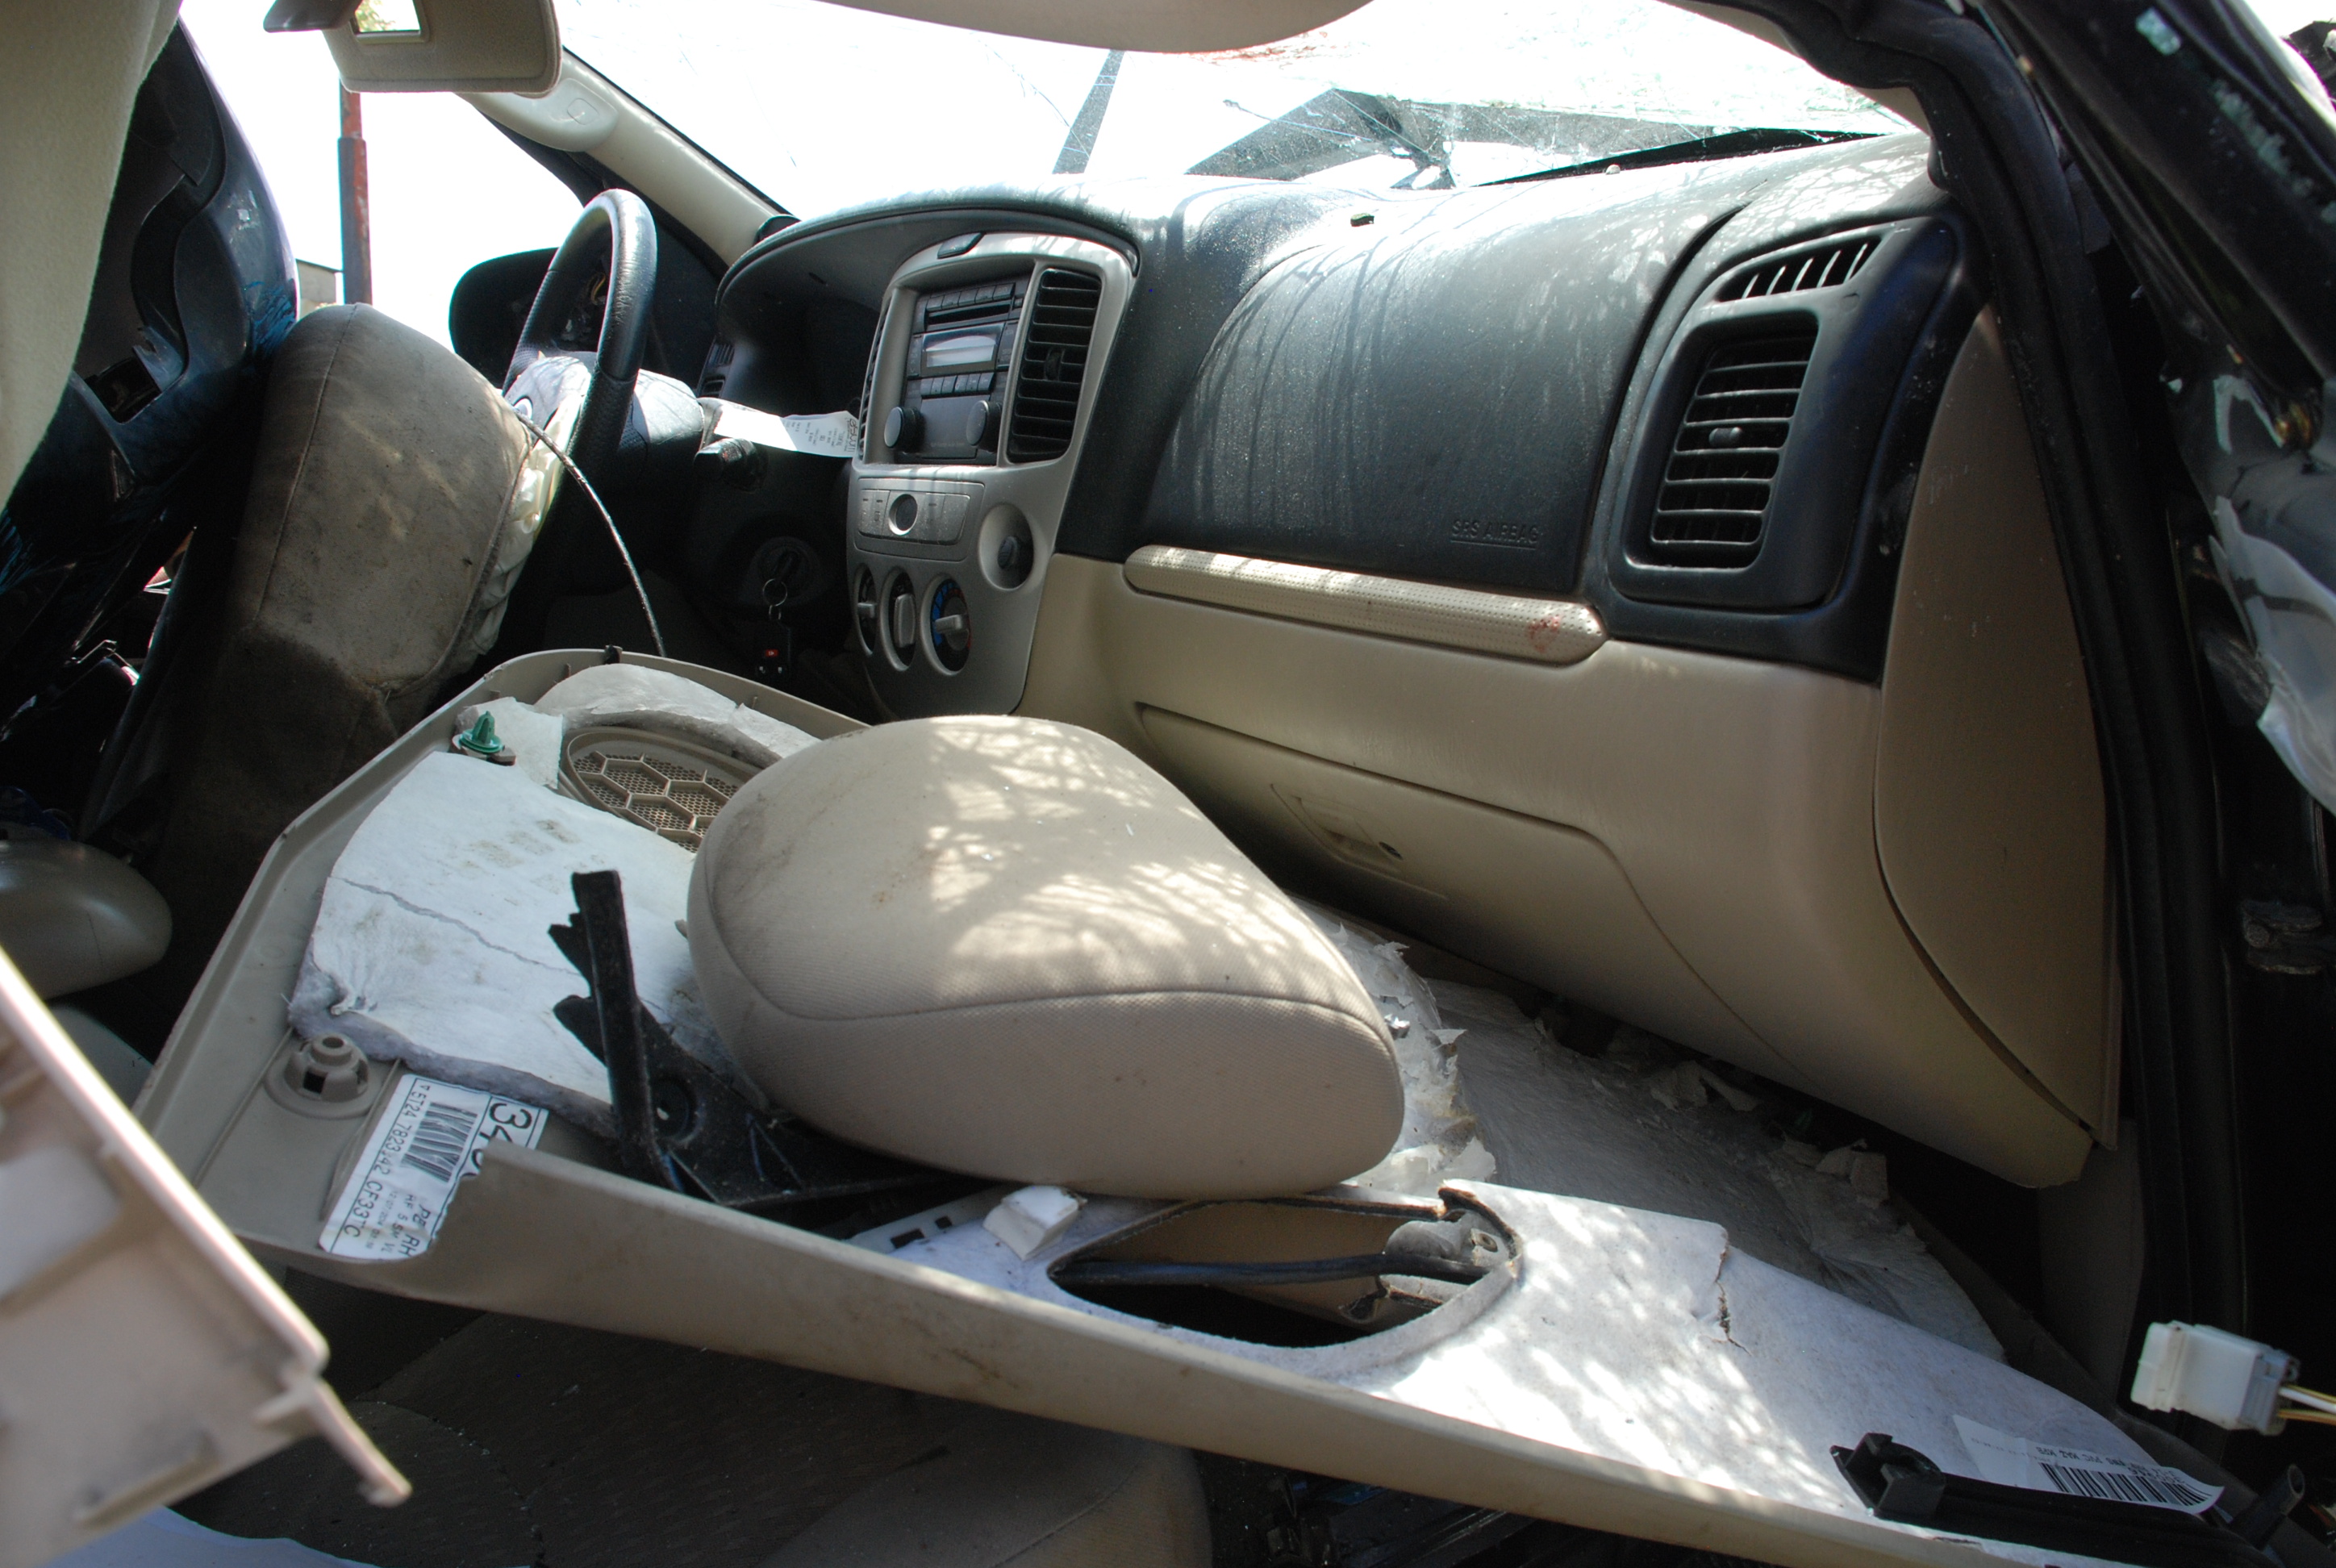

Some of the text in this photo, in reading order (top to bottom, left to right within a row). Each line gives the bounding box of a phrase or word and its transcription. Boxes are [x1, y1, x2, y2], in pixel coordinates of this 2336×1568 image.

[1451, 519, 1538, 544] SRS AIRBAG
[404, 1091, 427, 1118] 5T24
